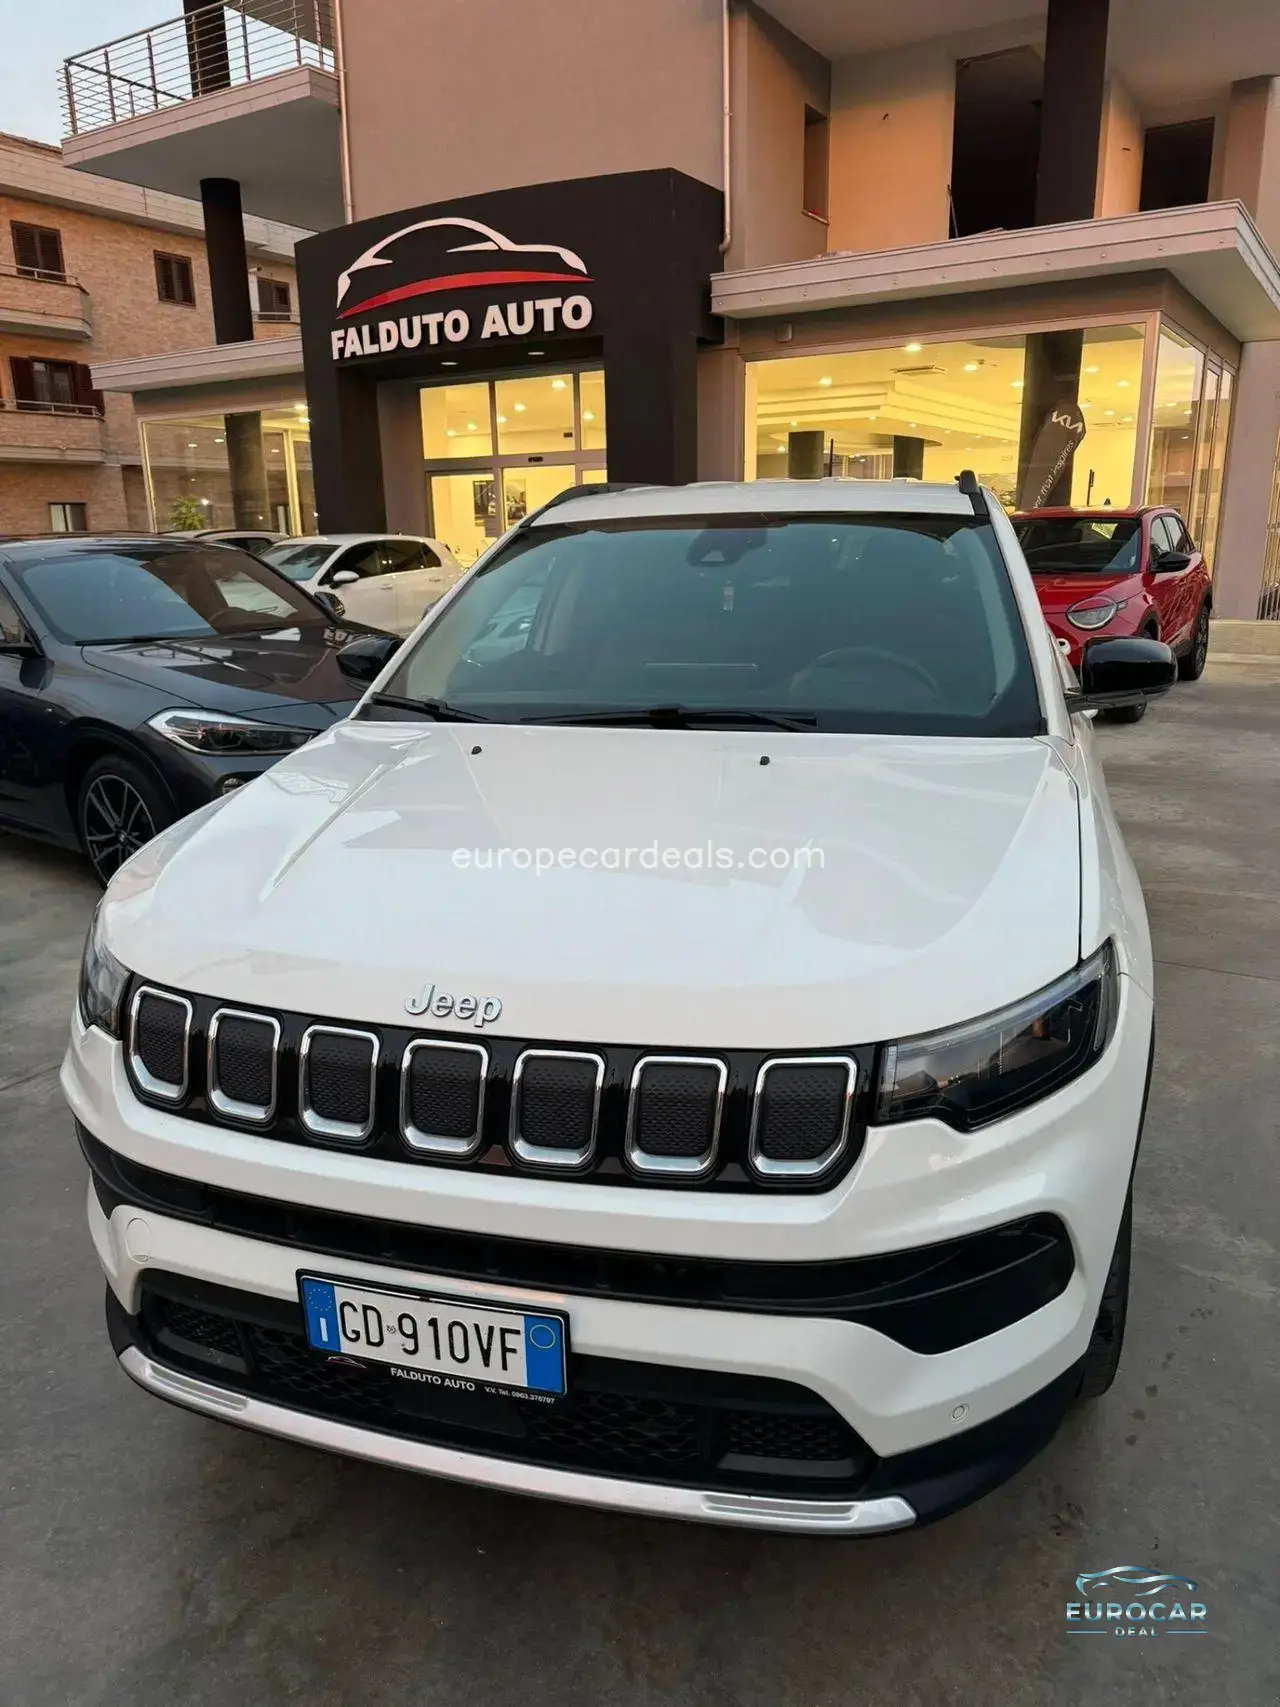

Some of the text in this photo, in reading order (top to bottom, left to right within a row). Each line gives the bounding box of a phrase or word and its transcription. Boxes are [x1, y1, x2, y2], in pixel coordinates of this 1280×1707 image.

[331, 295, 593, 361] FALDUTO AUTO
[404, 982, 502, 1028] Jeep
[390, 1367, 442, 1386] FALDUTO
[443, 1376, 476, 1392] AUTO
